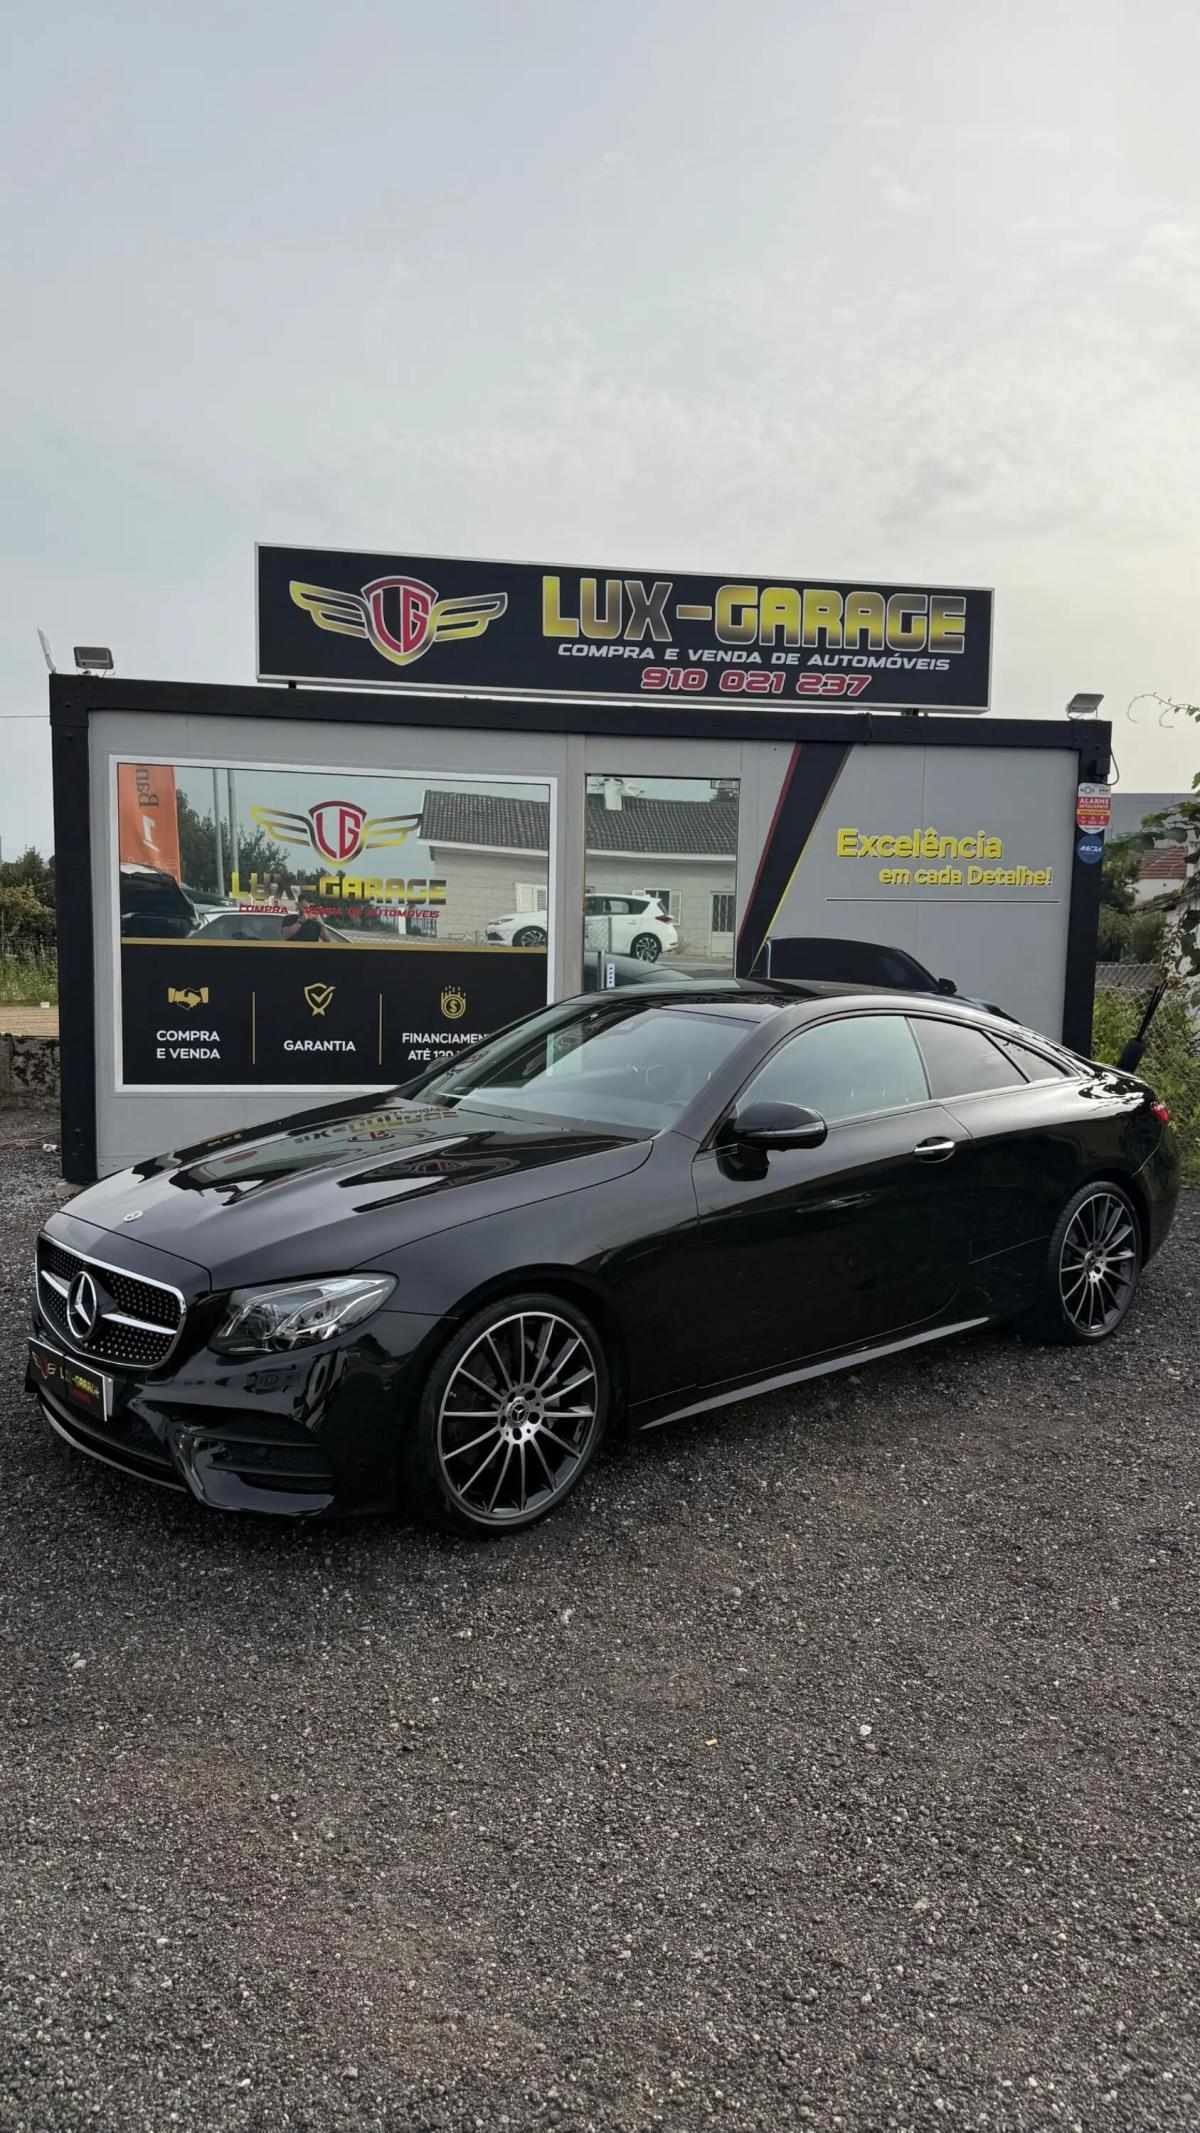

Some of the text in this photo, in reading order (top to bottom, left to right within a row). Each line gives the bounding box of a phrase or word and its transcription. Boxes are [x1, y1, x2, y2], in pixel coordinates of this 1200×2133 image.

[542, 576, 967, 654] LUX-GARAGE
[558, 644, 950, 671] COMPRA E VENDA DE AUTOMÓVEIS
[641, 667, 871, 696] 910 021 237
[837, 827, 1003, 859] Excelência
[879, 865, 1053, 887] em cada Detalhe!
[156, 1030, 220, 1042] COMPRA
[402, 1032, 489, 1044] FINANCIAMEN
[156, 1048, 221, 1059] E VENDA
[283, 1040, 356, 1052] GARANTIA
[407, 1048, 431, 1061] ATÉ
